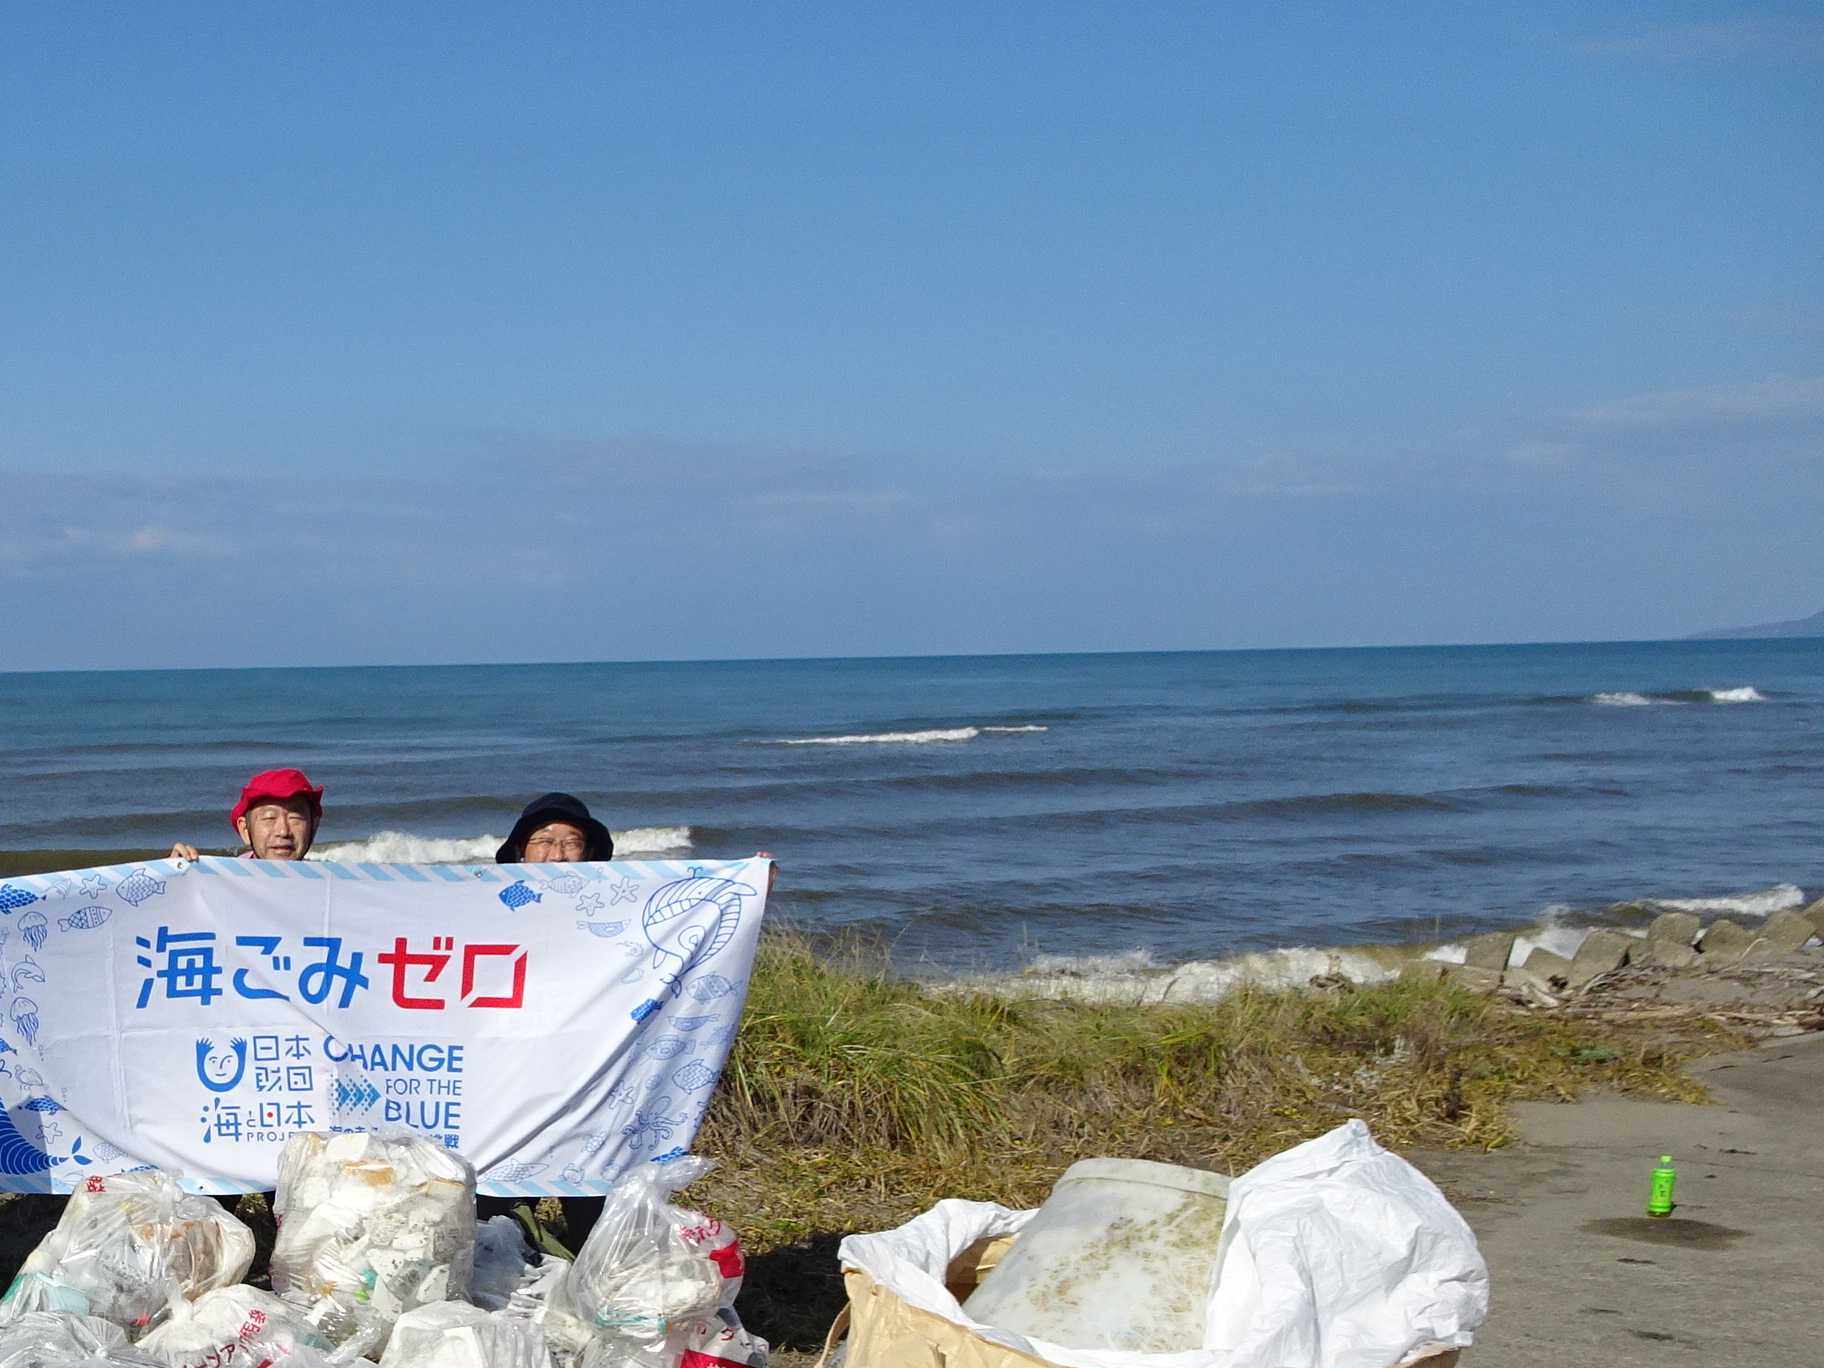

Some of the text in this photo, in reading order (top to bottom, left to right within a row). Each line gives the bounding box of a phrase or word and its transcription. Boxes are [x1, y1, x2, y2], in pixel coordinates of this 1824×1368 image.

[135, 925, 529, 1010] 海ごみゼロ
[252, 1034, 312, 1061] 日本
[323, 1035, 465, 1074] CHANGE
[385, 1078, 463, 1097] FOR THE
[200, 1097, 315, 1143] 海と日本
[384, 1098, 462, 1131] BLUE
[246, 1131, 296, 1143] PROJ
